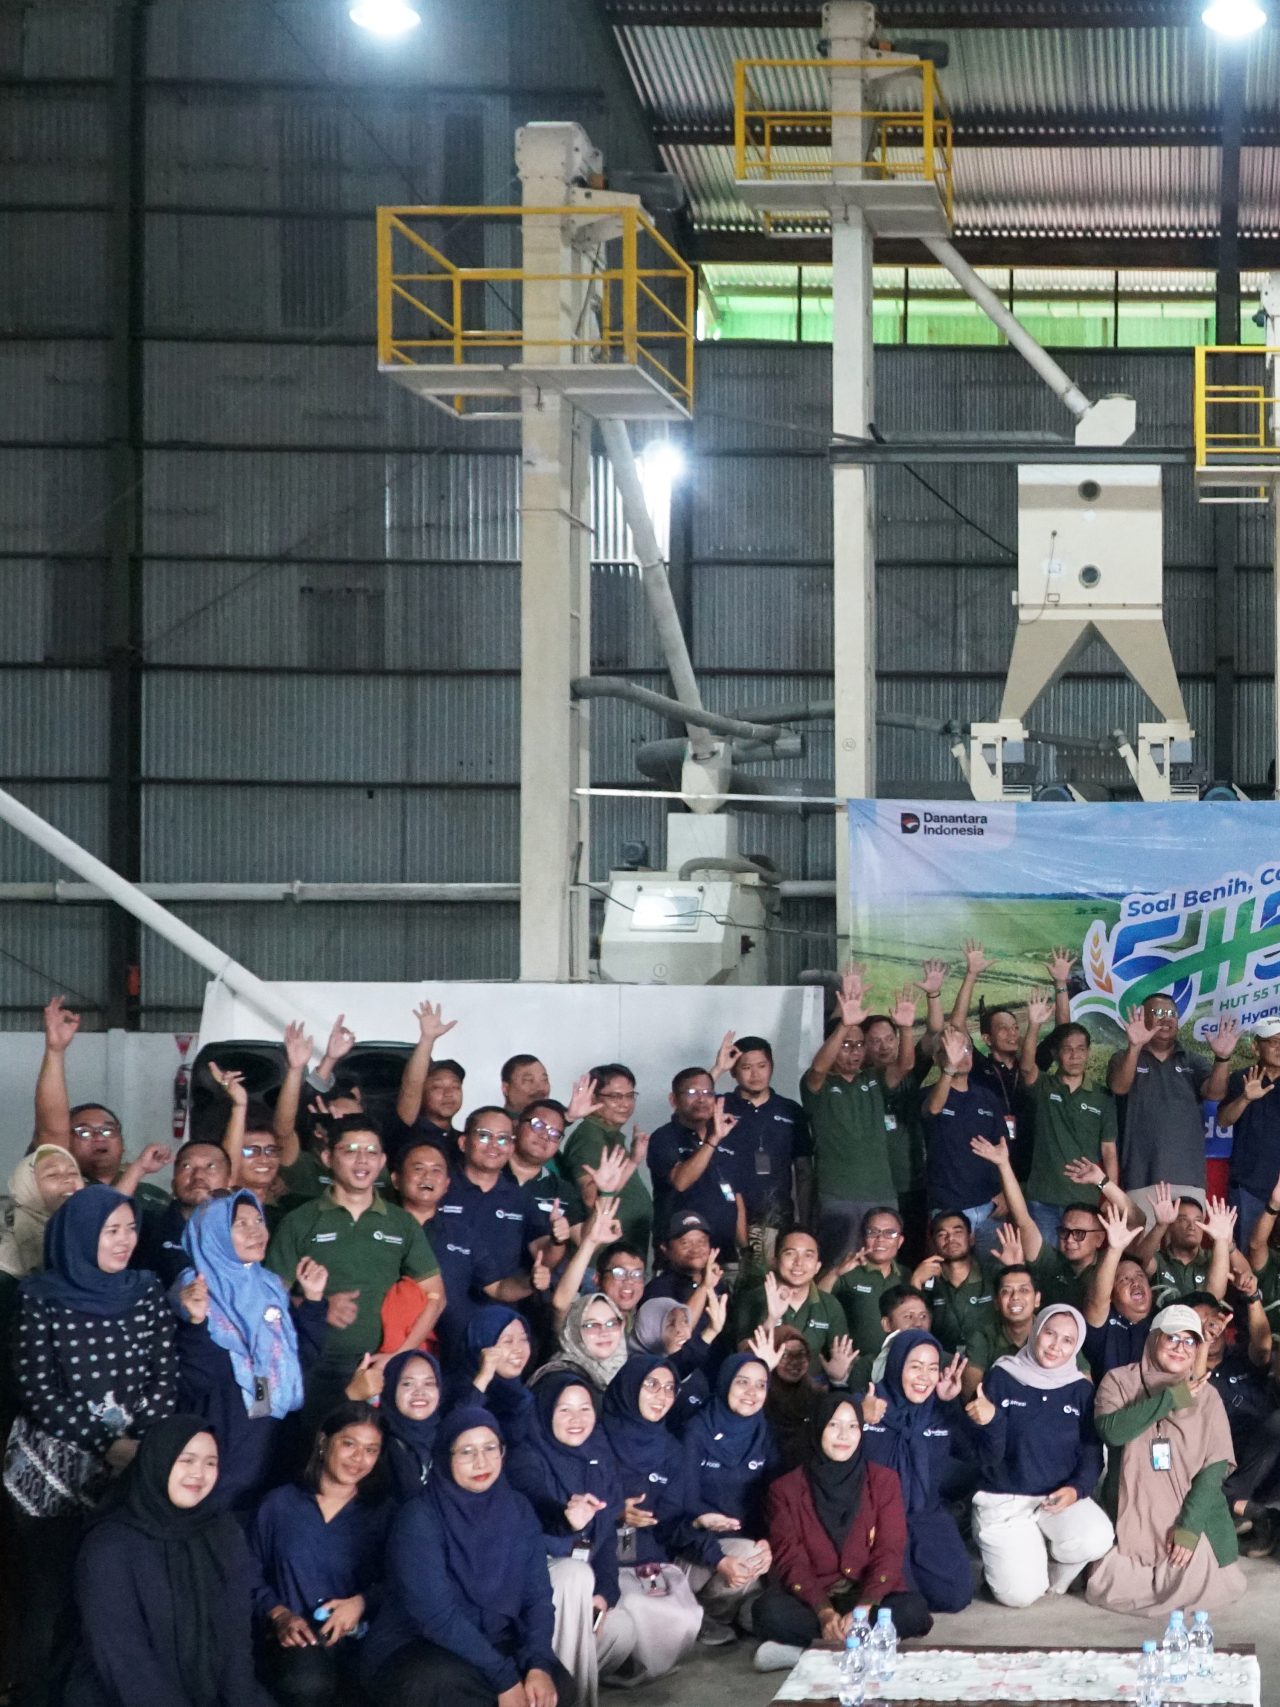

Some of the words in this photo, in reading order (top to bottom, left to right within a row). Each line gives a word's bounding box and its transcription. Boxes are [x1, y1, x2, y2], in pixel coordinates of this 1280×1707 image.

[923, 811, 988, 824] Danantara
[923, 824, 985, 836] Indonesia
[1127, 892, 1177, 917] Soal
[1183, 877, 1254, 908] Benih,
[1219, 993, 1249, 1012] HUT
[1253, 986, 1269, 1002] 55
